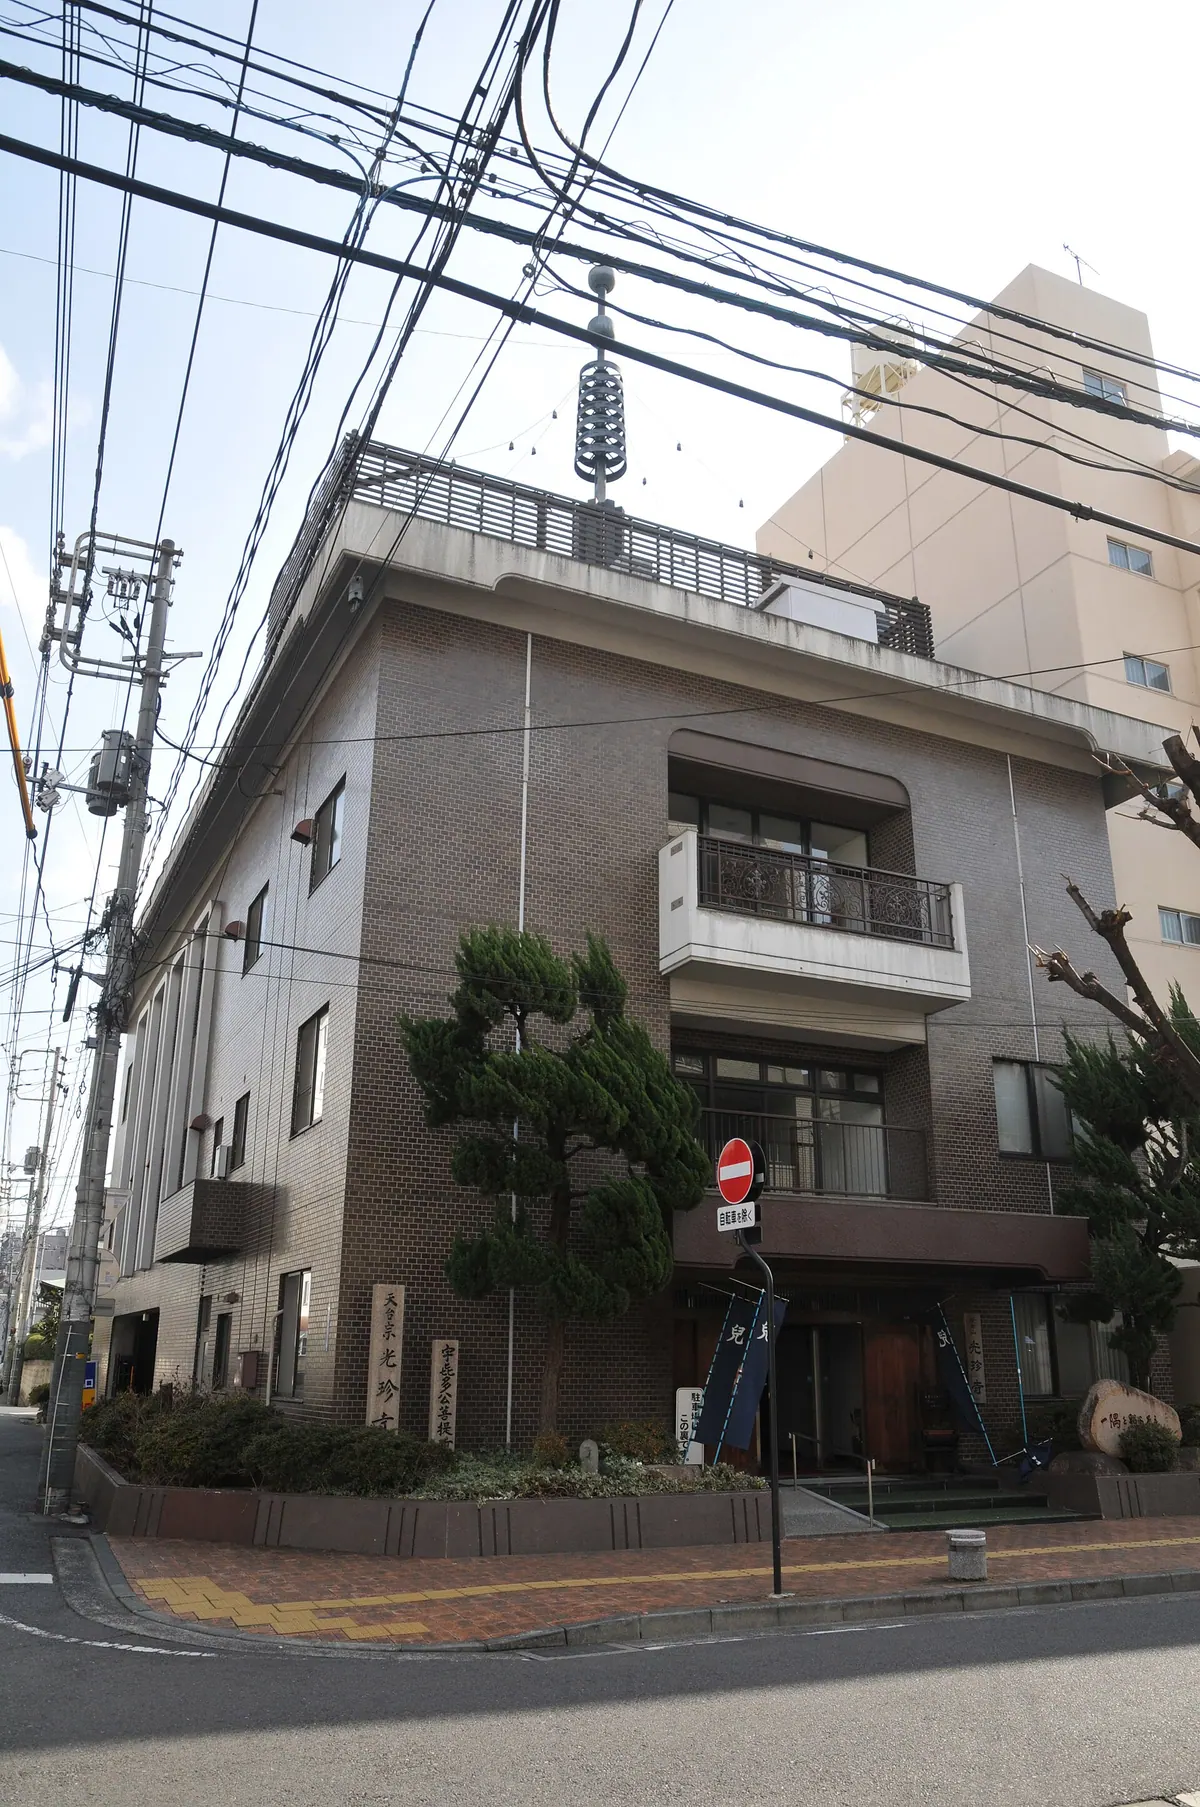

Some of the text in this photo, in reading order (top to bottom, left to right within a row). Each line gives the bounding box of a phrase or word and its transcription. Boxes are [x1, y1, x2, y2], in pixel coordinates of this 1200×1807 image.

[720, 1208, 752, 1226] 自転車を除く
